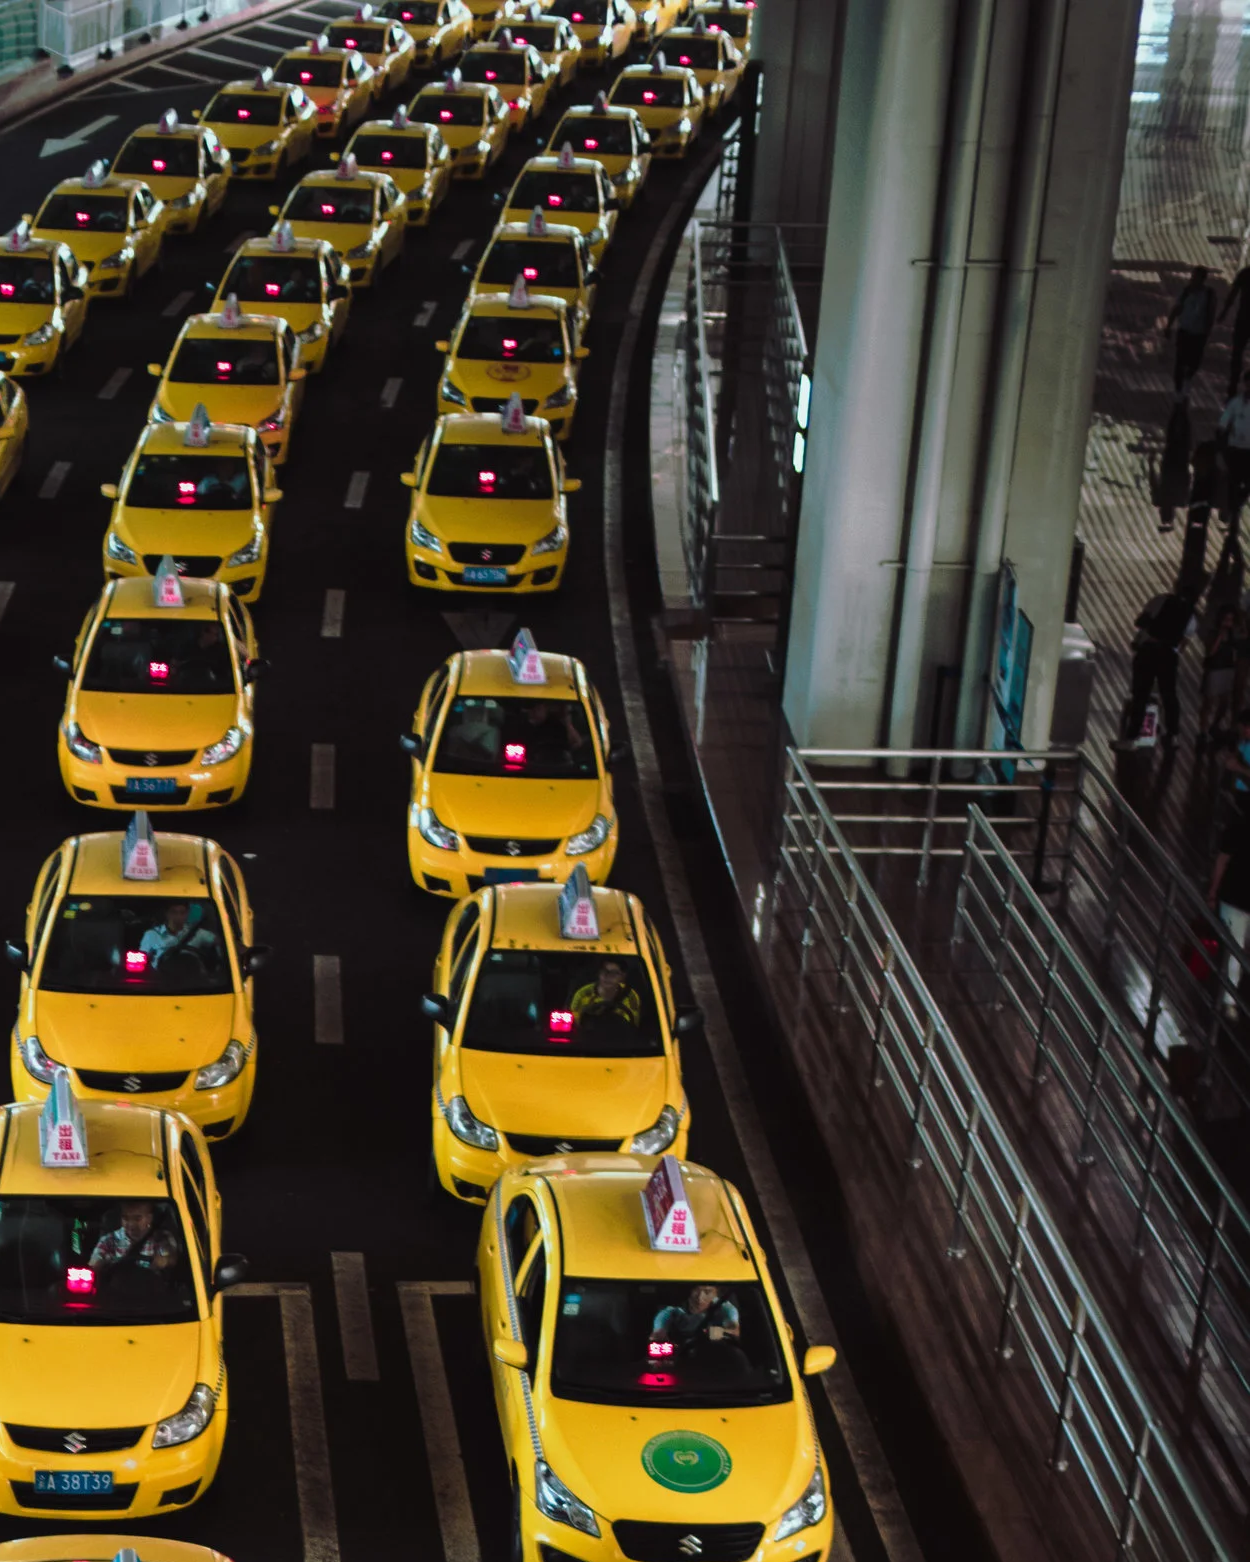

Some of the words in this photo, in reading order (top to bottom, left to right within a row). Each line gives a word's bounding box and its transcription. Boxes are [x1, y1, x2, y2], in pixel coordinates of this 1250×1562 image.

[570, 926, 596, 935] TAXI
[58, 1124, 73, 1150] 出租
[52, 1151, 81, 1161] TAXI
[671, 1209, 687, 1235] 出租
[663, 1236, 692, 1246] TAXI
[649, 1342, 674, 1356] 空车
